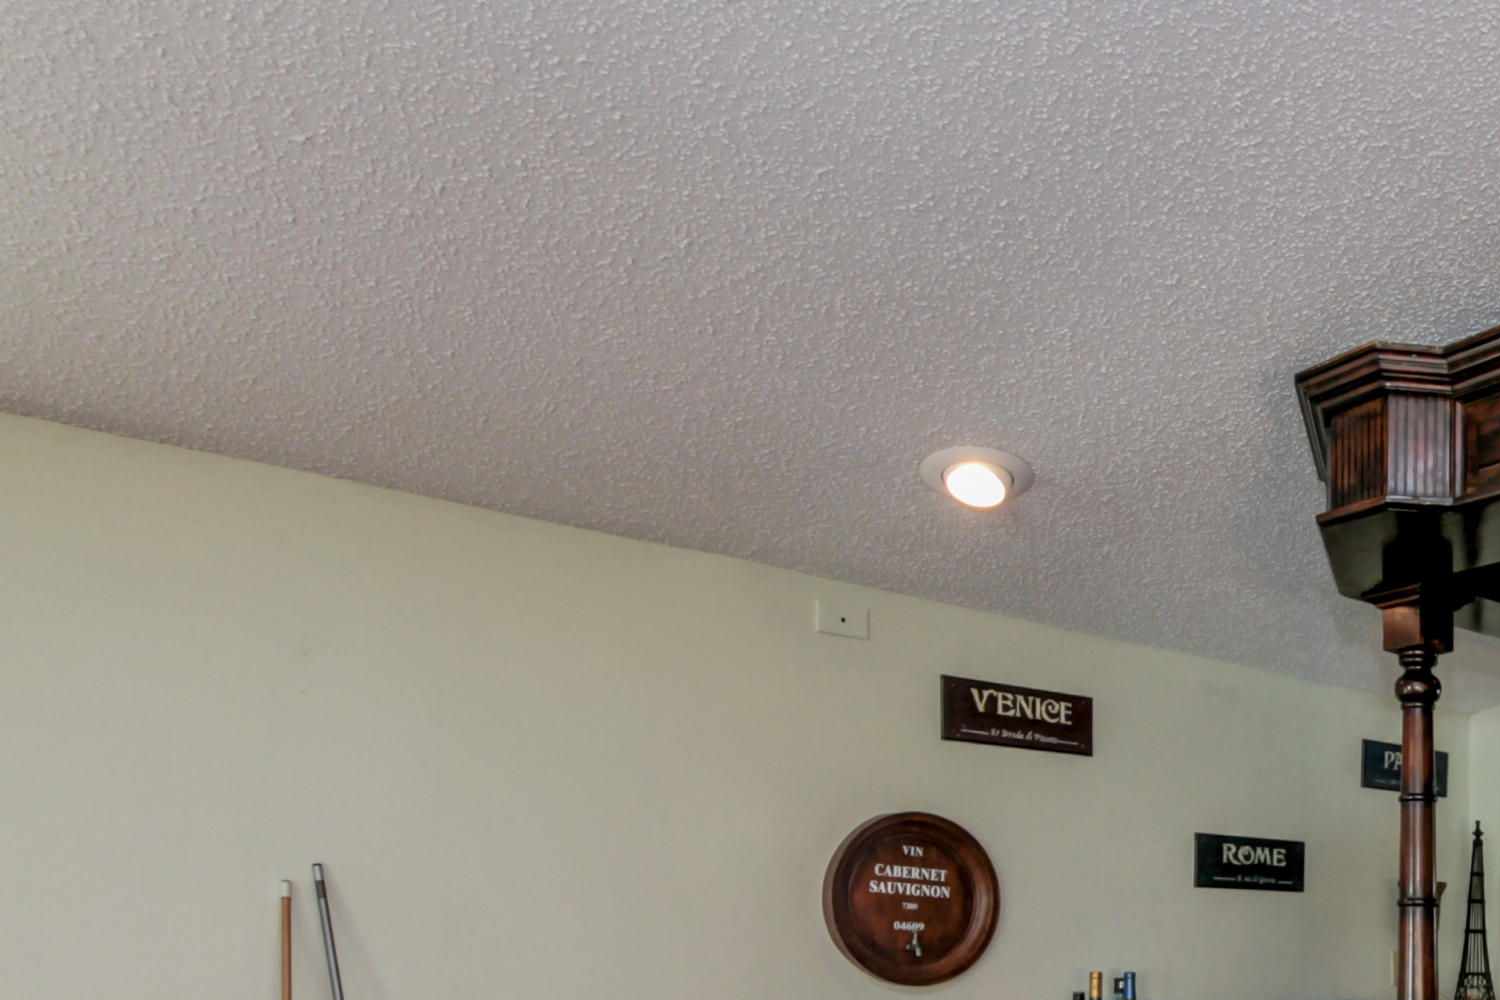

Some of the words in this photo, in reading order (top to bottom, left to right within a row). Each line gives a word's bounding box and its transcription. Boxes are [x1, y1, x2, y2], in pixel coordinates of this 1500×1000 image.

[970, 687, 1073, 726] VENICE
[902, 844, 924, 857] VIN
[1222, 842, 1287, 867] ROME
[874, 863, 948, 882] CABERNET
[868, 880, 951, 899] SAUVIGNON
